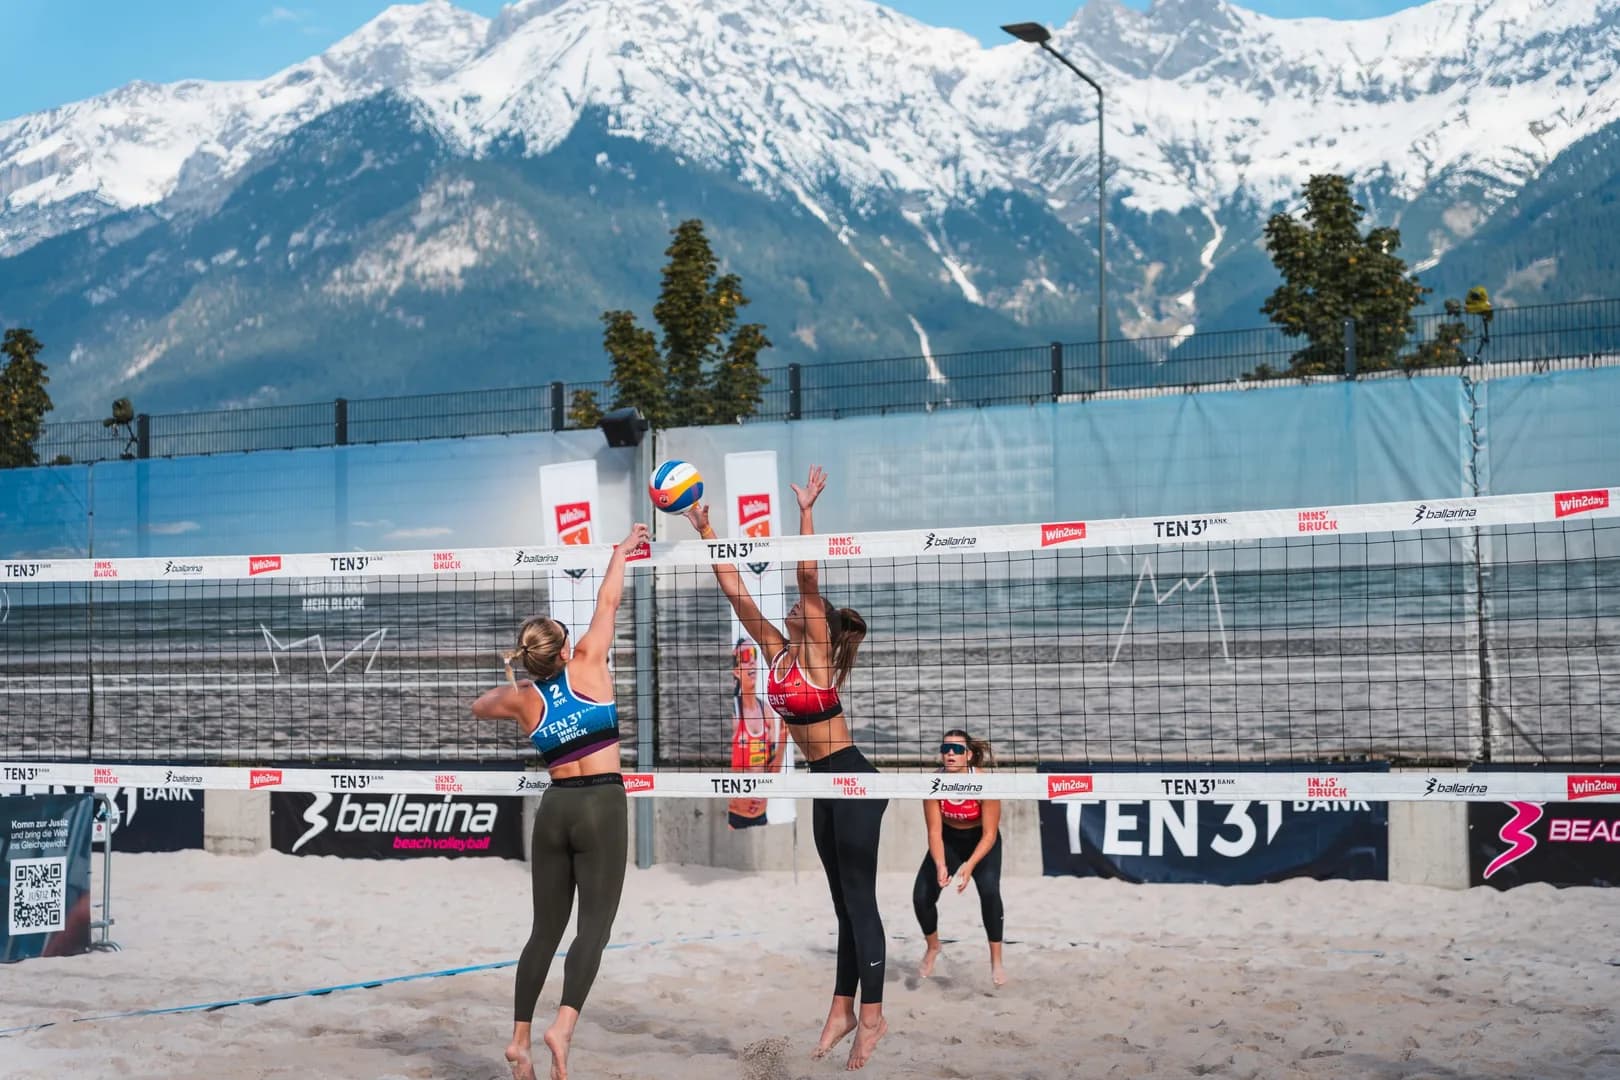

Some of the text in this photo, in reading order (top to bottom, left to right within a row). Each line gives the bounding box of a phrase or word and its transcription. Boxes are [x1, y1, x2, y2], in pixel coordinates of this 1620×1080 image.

[1560, 495, 1604, 512] win2day
[1426, 508, 1477, 519] ballarina
[1298, 520, 1338, 532] BRUCK
[1046, 527, 1082, 541] win2day
[934, 535, 977, 546] ballarina
[828, 546, 862, 556] BRUCK
[523, 553, 559, 563] ballarina
[433, 560, 462, 569] BRUCK
[549, 684, 563, 699] 2
[553, 697, 568, 708] SVK
[560, 728, 588, 744] BRUCK
[253, 775, 280, 786] win2day
[940, 782, 982, 792] ballarina
[1052, 780, 1089, 793] win2day
[1308, 787, 1347, 797] BRUCK
[1437, 783, 1488, 793] ballarina
[1572, 779, 1617, 794] win2day
[335, 794, 498, 832] ballarina
[11, 820, 35, 829] Komm
[36, 820, 48, 828] zur
